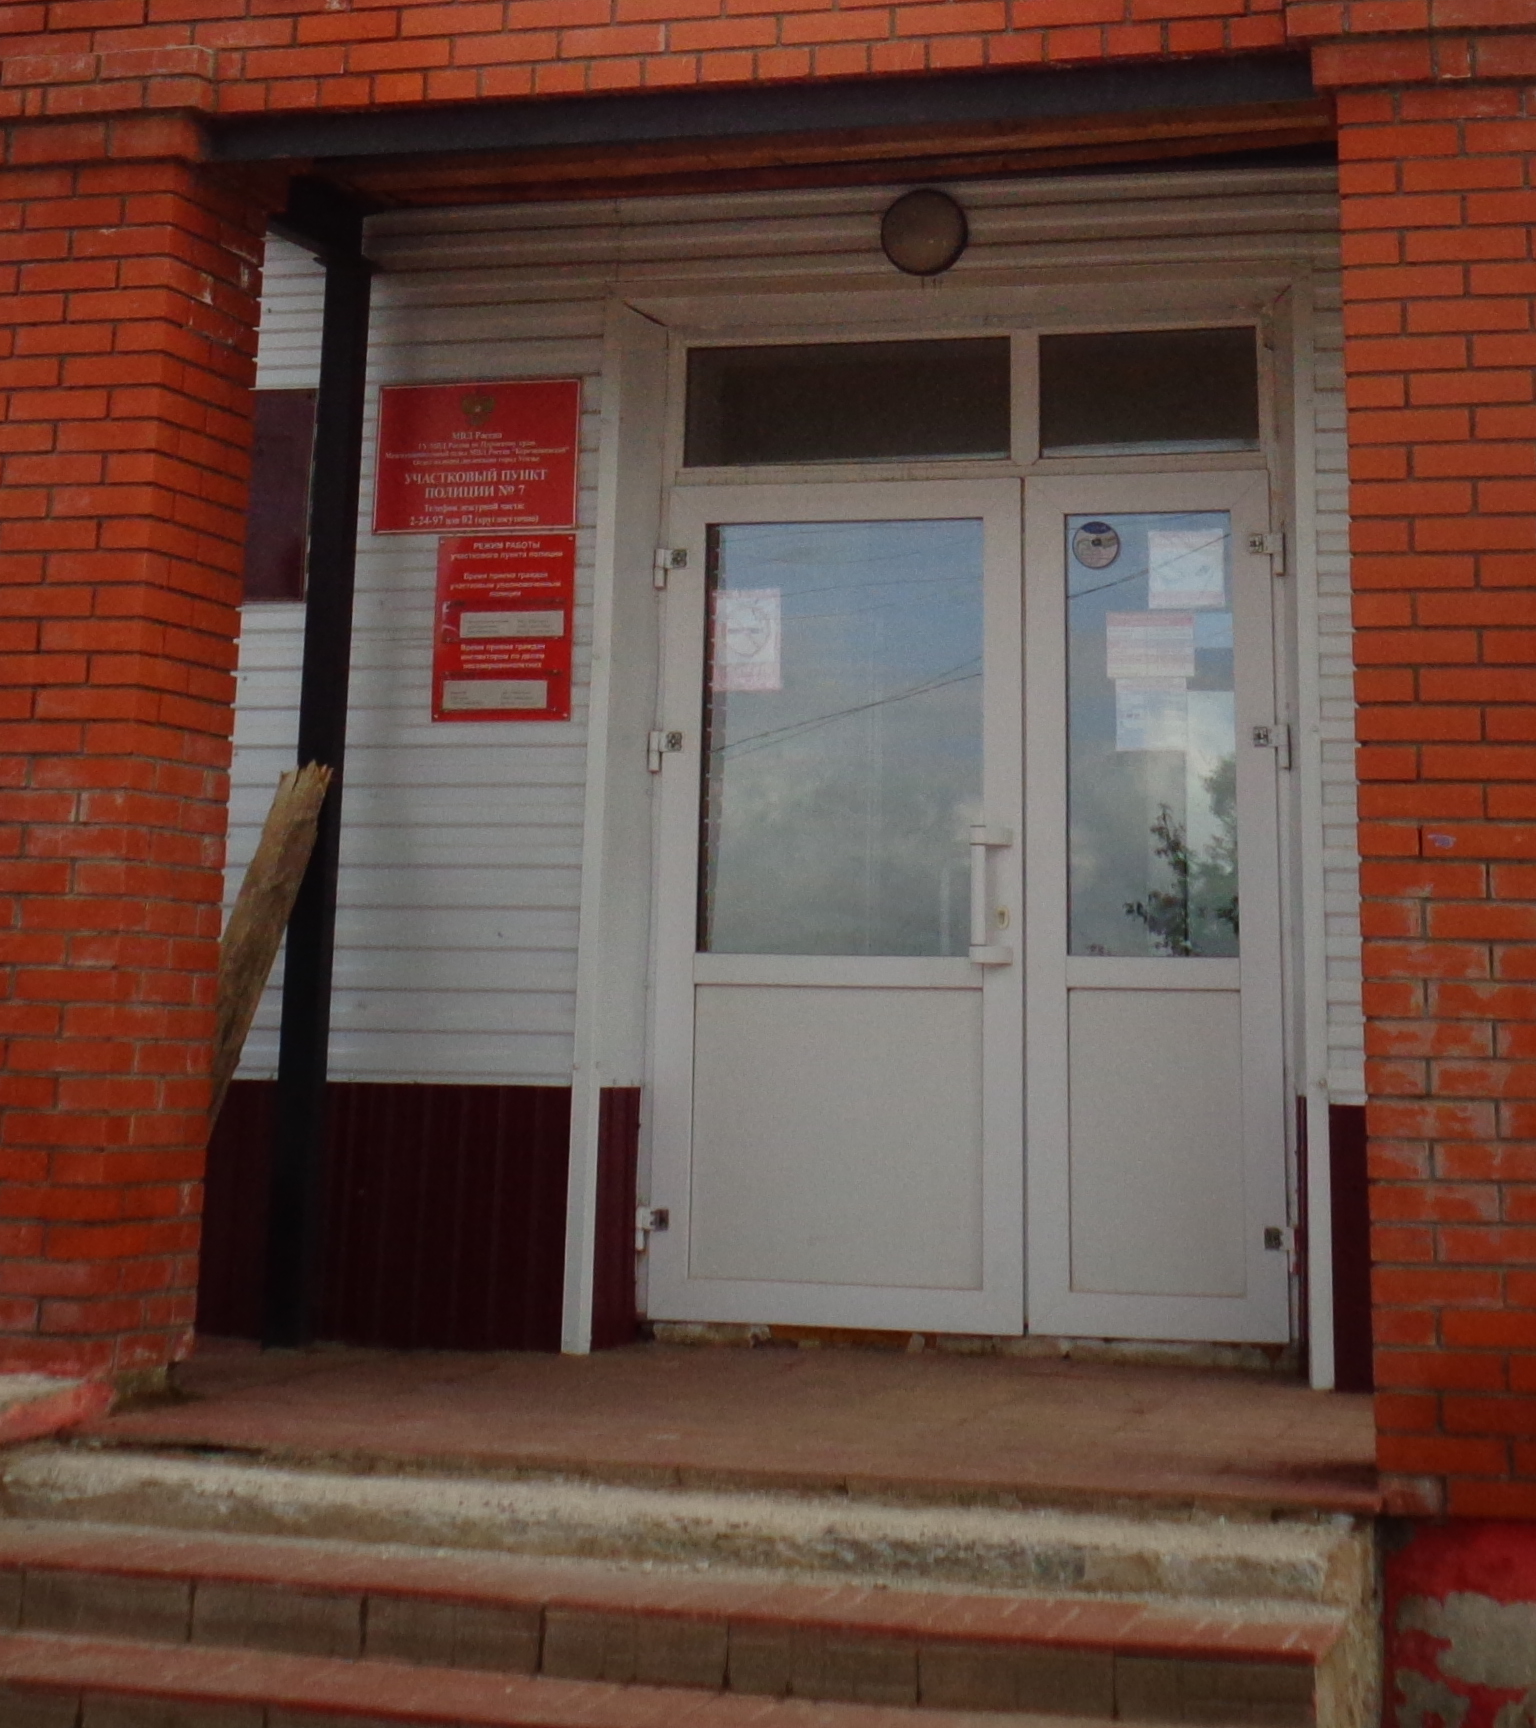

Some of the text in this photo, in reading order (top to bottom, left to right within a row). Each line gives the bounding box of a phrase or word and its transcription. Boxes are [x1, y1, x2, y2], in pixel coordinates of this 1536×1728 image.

[404, 469, 548, 484] УЧАСТКОВЫЙ ПУНКТ
[425, 485, 494, 499] ПОЛИЦИИ
[518, 484, 526, 495] 7
[505, 541, 540, 549] РАБОТЫ
